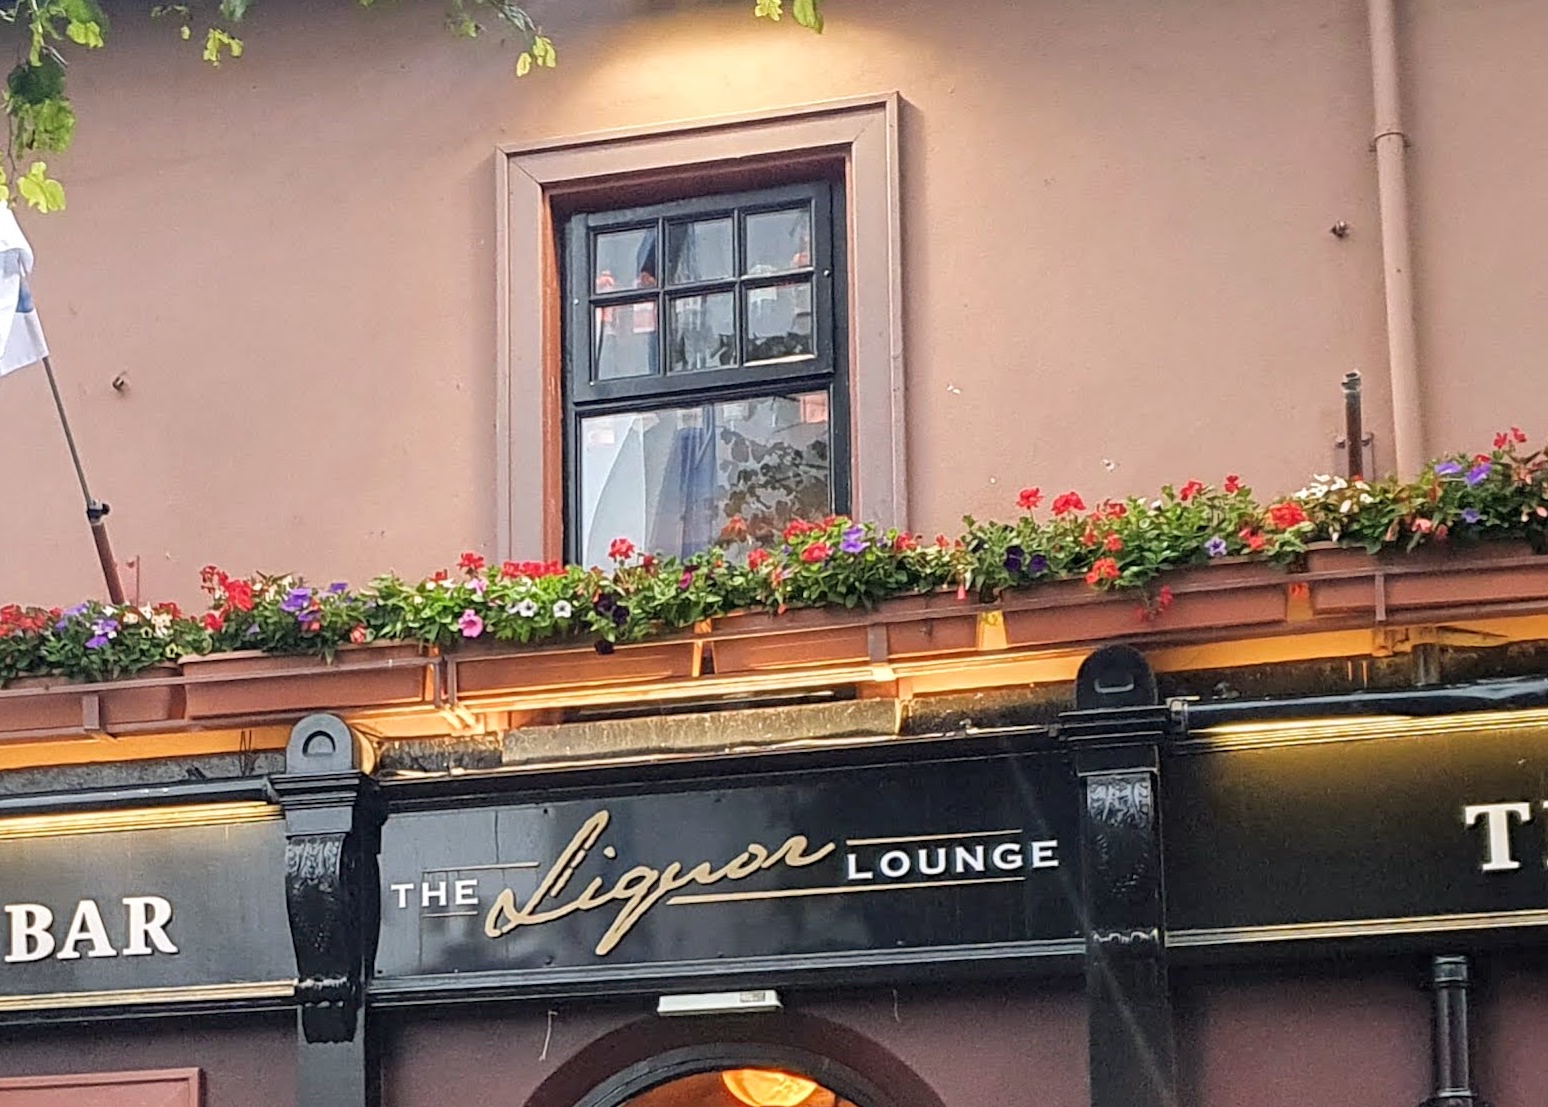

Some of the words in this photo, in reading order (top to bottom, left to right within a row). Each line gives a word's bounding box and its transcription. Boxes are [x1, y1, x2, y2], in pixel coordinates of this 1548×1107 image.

[1465, 801, 1548, 871] T
[390, 878, 479, 909] THE
[484, 809, 836, 956] Liquor
[846, 838, 1059, 882] LOUNGE
[3, 893, 177, 964] BAR
